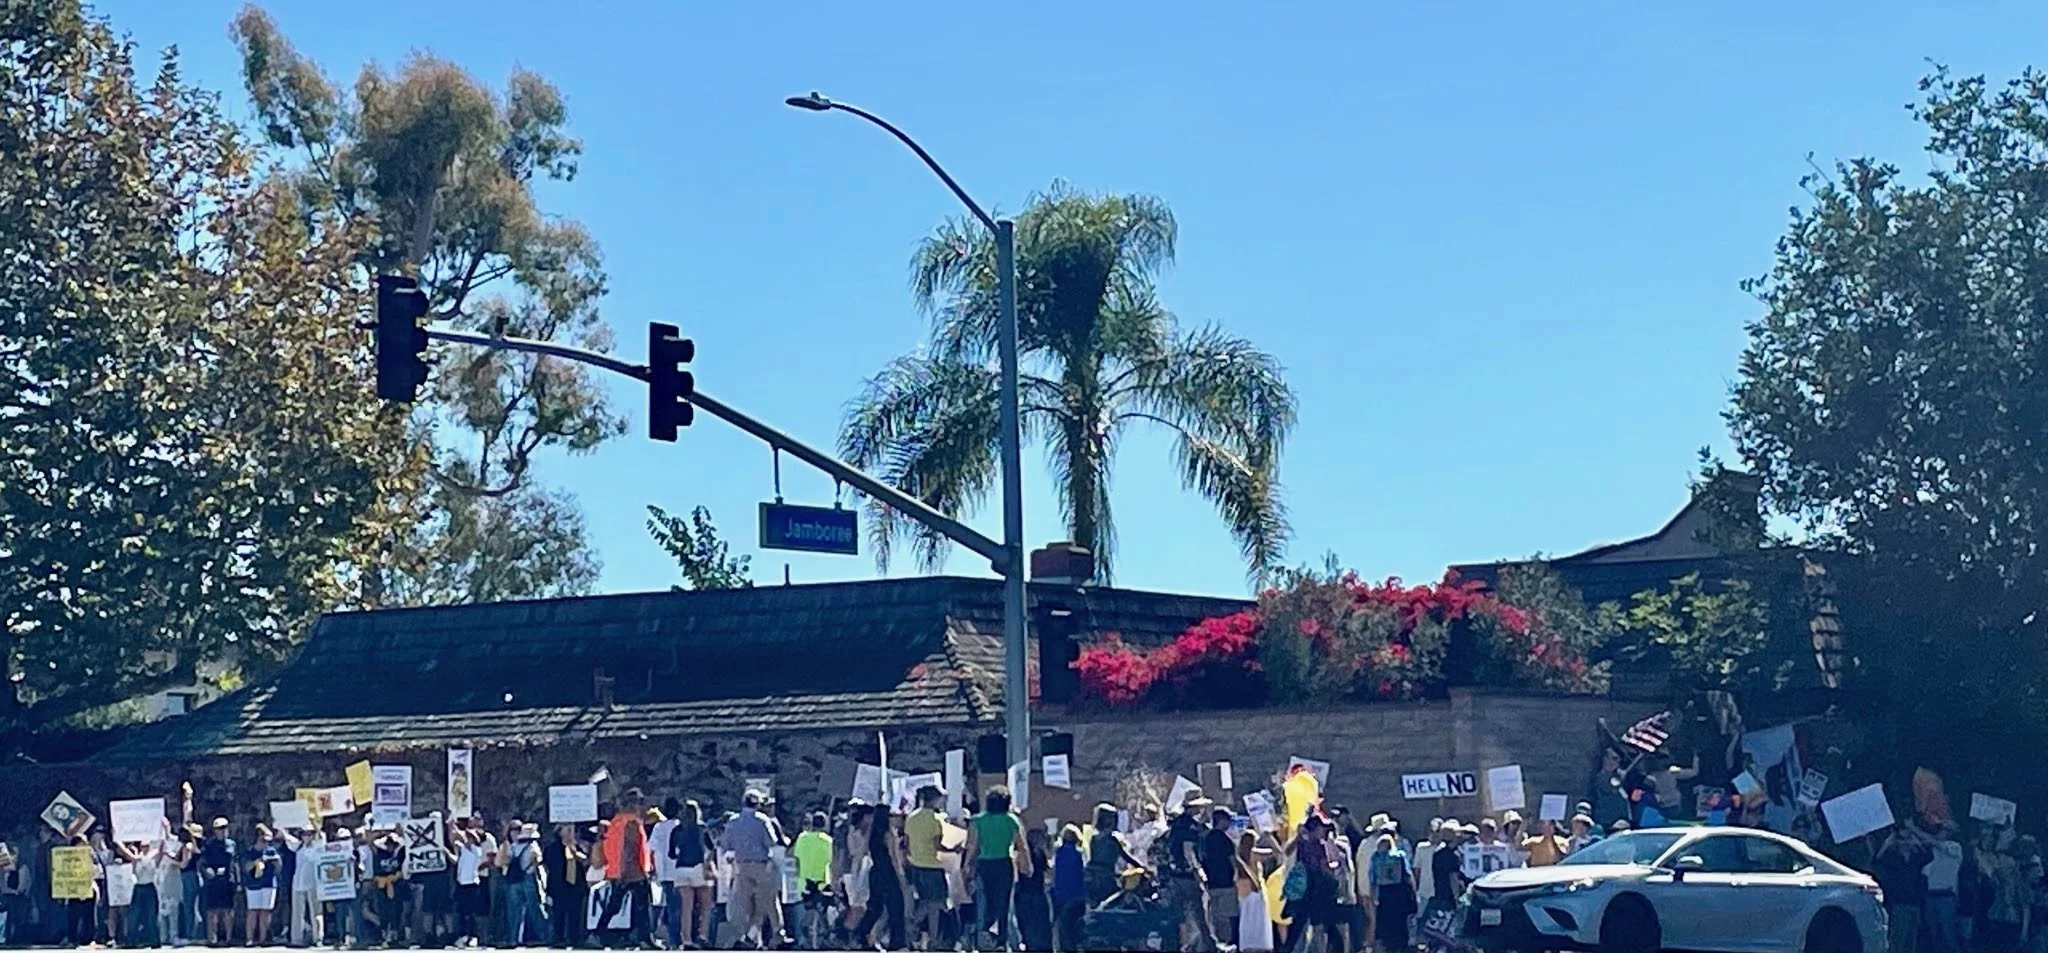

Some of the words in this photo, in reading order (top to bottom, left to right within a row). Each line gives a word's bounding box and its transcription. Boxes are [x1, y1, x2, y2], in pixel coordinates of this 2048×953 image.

[784, 517, 852, 543] Jamboree
[1405, 778, 1446, 794] HELL
[1446, 773, 1477, 794] NO
[409, 850, 440, 861] NO
